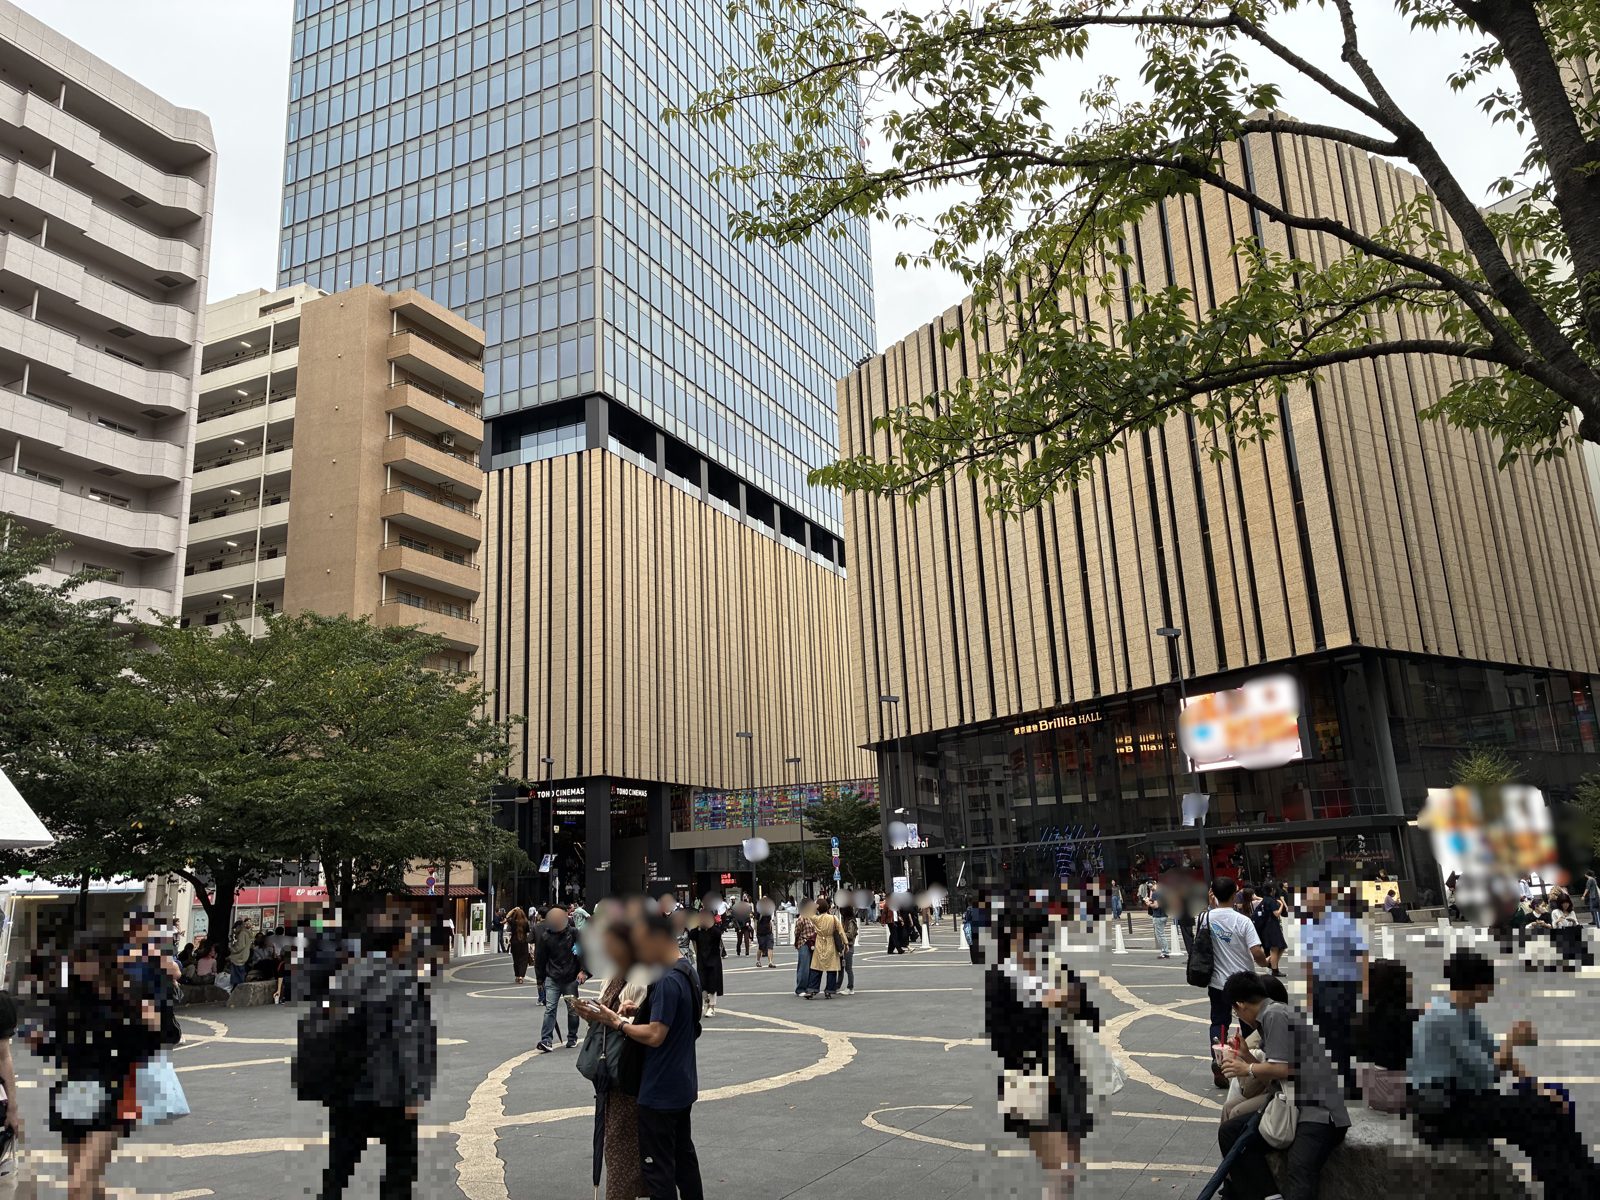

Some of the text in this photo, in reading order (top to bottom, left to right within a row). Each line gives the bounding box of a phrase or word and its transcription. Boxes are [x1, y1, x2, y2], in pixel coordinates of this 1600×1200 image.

[1039, 716, 1077, 731] Brillia
[1078, 712, 1102, 724] HALL
[537, 788, 585, 798] TOHO CINEMAS
[616, 788, 648, 797] TOHO CINEMAS
